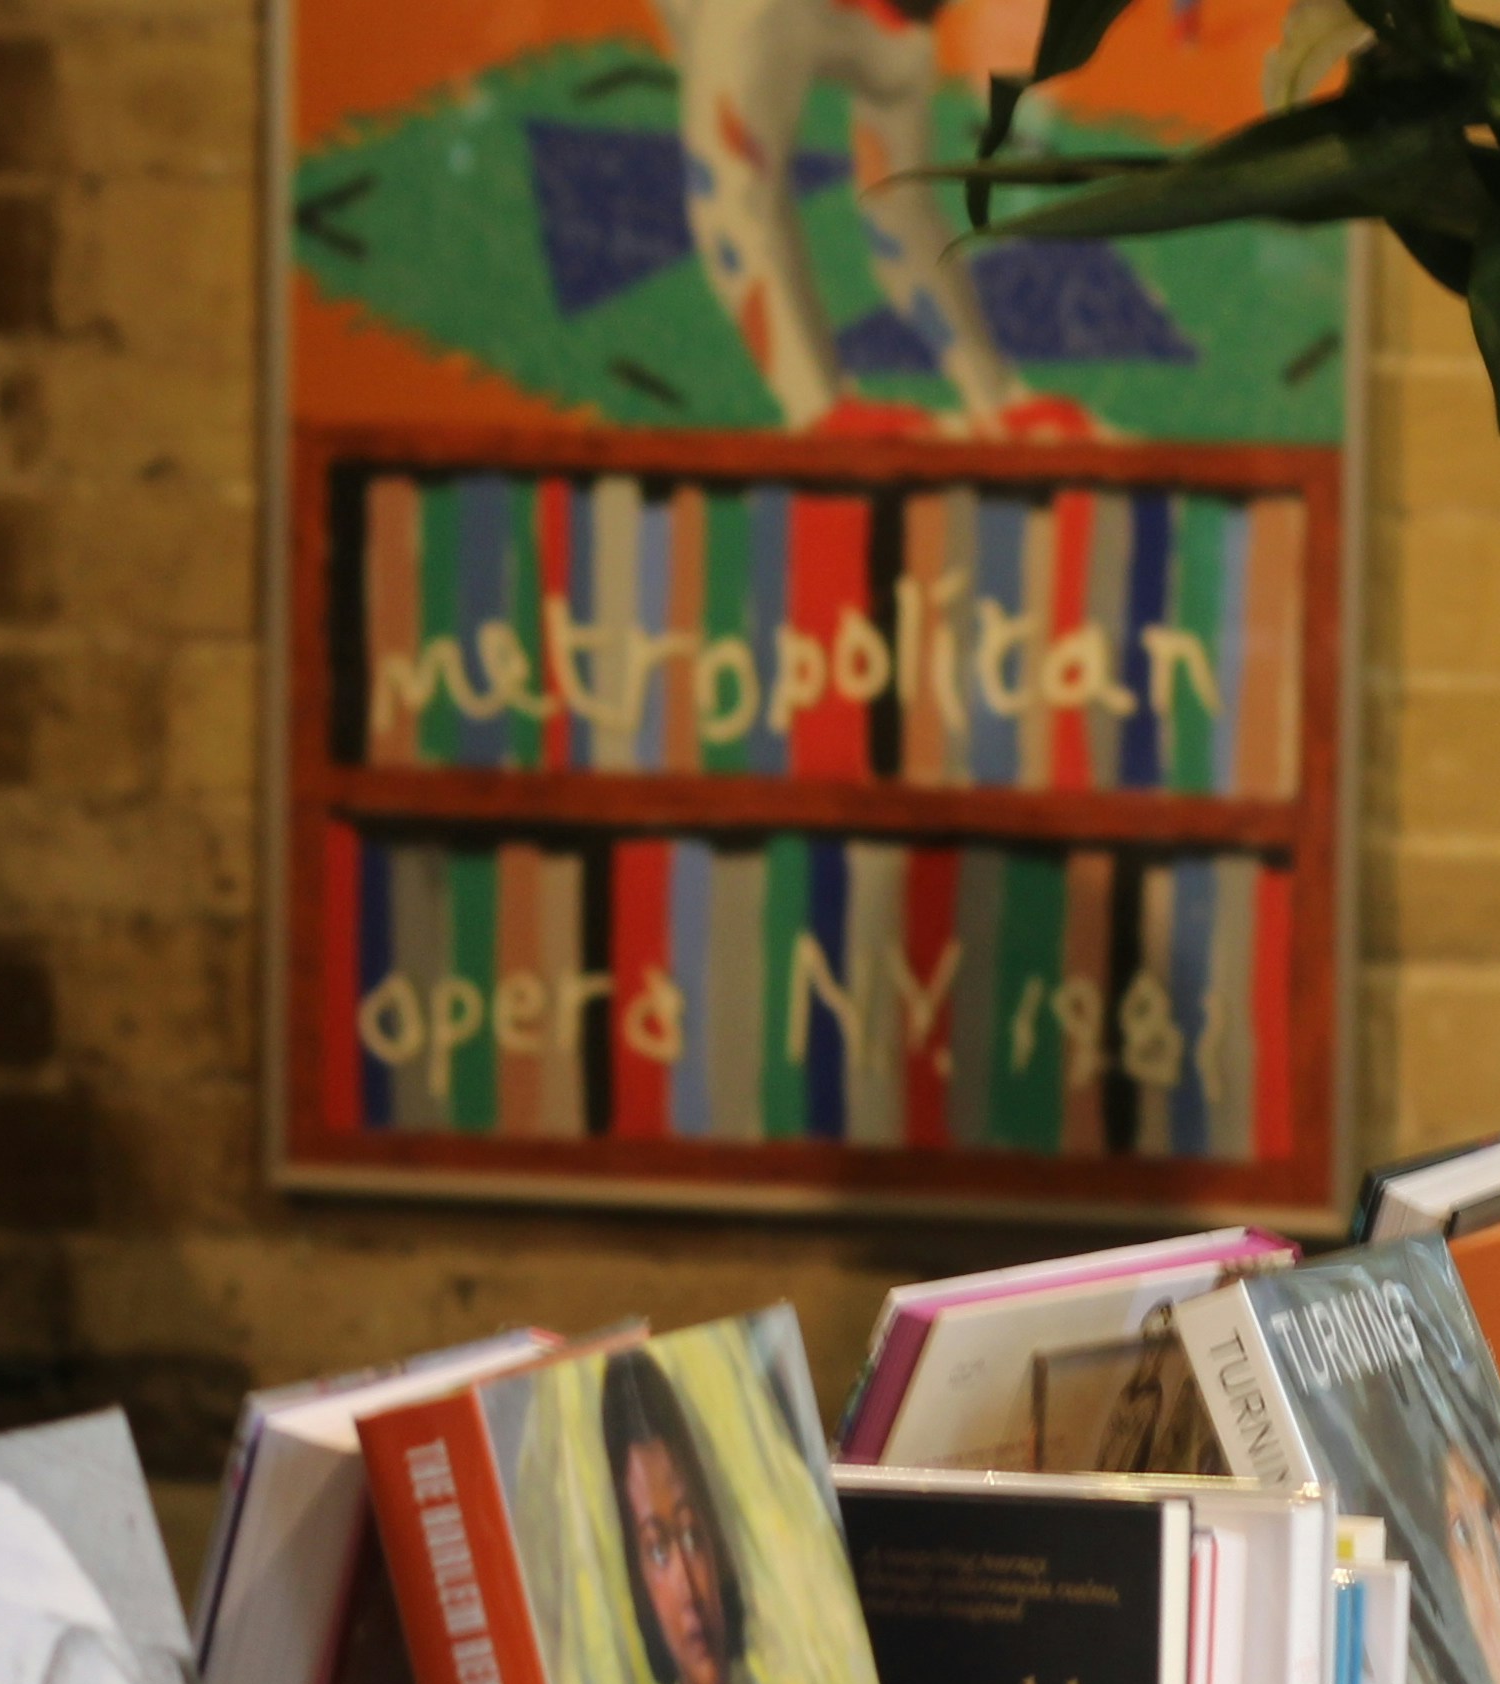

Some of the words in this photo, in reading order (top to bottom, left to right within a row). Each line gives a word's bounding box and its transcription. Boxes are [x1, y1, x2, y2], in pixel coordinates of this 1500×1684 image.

[371, 569, 1222, 742] metropolitan
[358, 968, 685, 1100] opera
[1208, 1326, 1295, 1486] TURNIN
[1269, 1276, 1427, 1396] TURNING
[405, 1434, 451, 1503] THE
[419, 1496, 484, 1655] HARLEM
